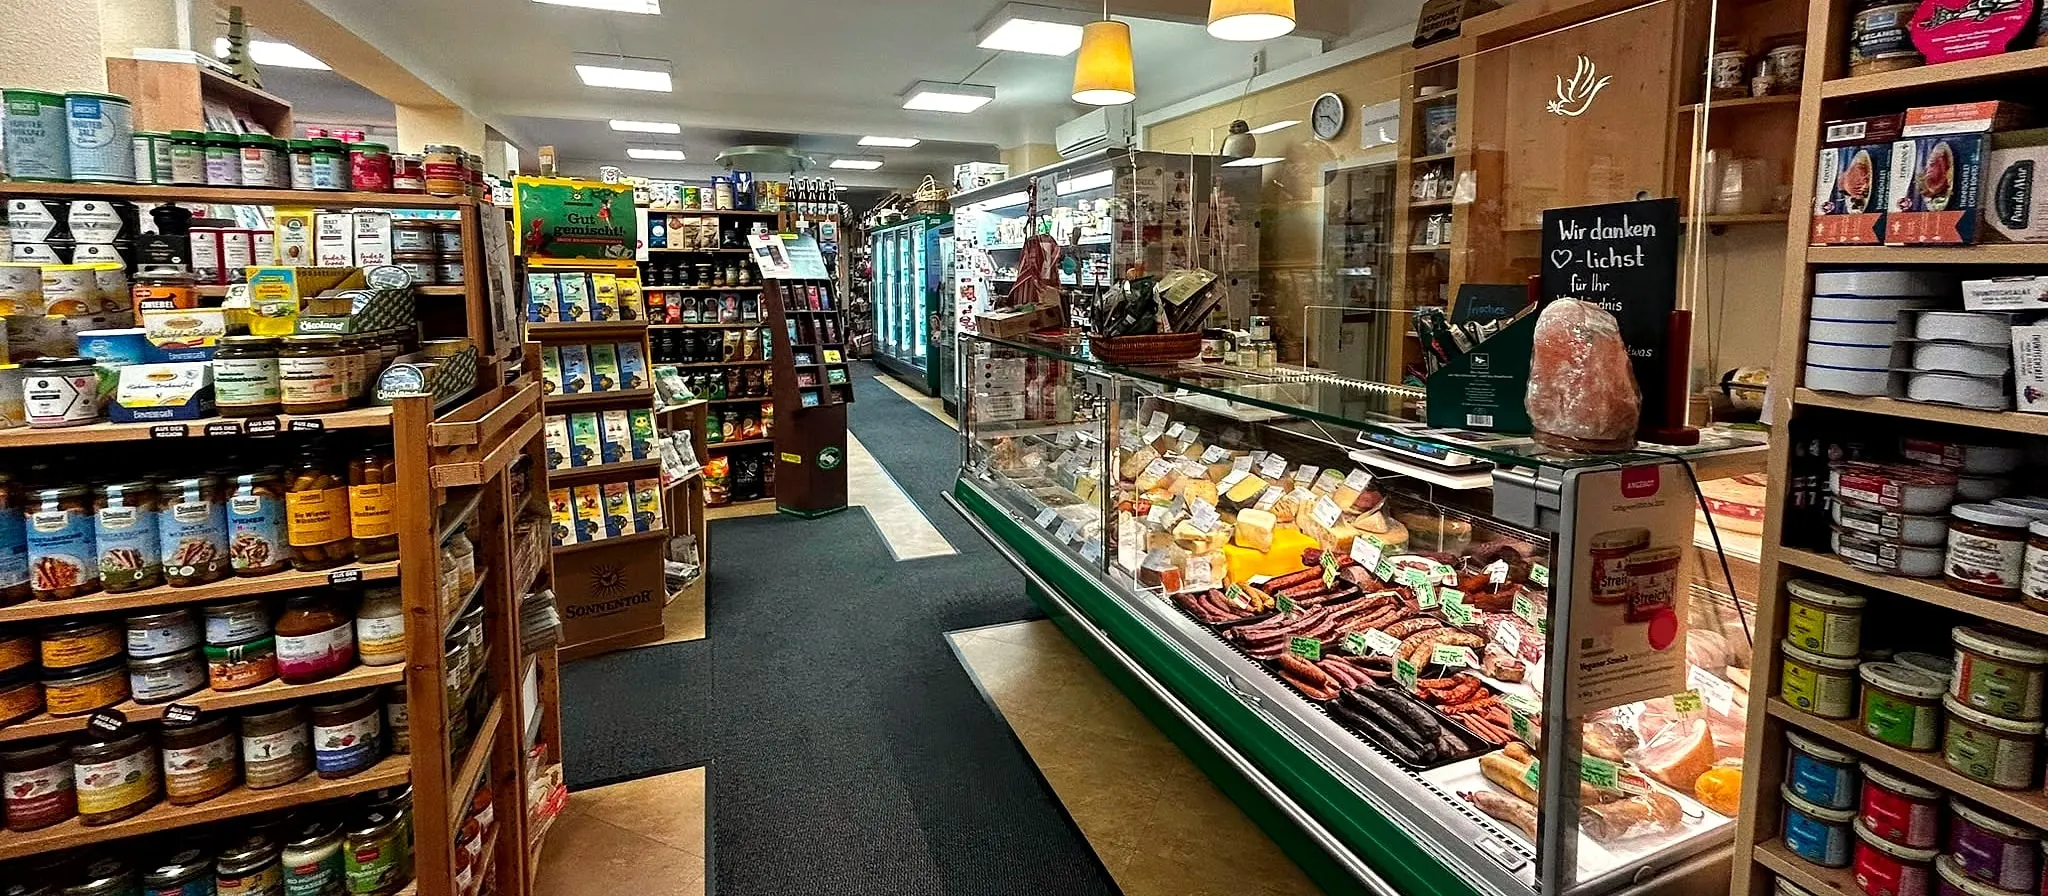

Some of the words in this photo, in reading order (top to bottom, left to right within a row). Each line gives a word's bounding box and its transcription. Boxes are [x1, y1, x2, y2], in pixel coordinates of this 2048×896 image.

[567, 212, 596, 225] Gut
[553, 225, 624, 237] gemischt!
[1559, 219, 1588, 241] Wir
[1589, 213, 1657, 240] danken
[1570, 273, 1588, 293] für
[1591, 272, 1611, 292] Ihr
[299, 320, 345, 331] Ökoland
[1625, 344, 1653, 358] twas
[565, 589, 655, 619] SONNENTOR
[1632, 588, 1668, 605] Streich
